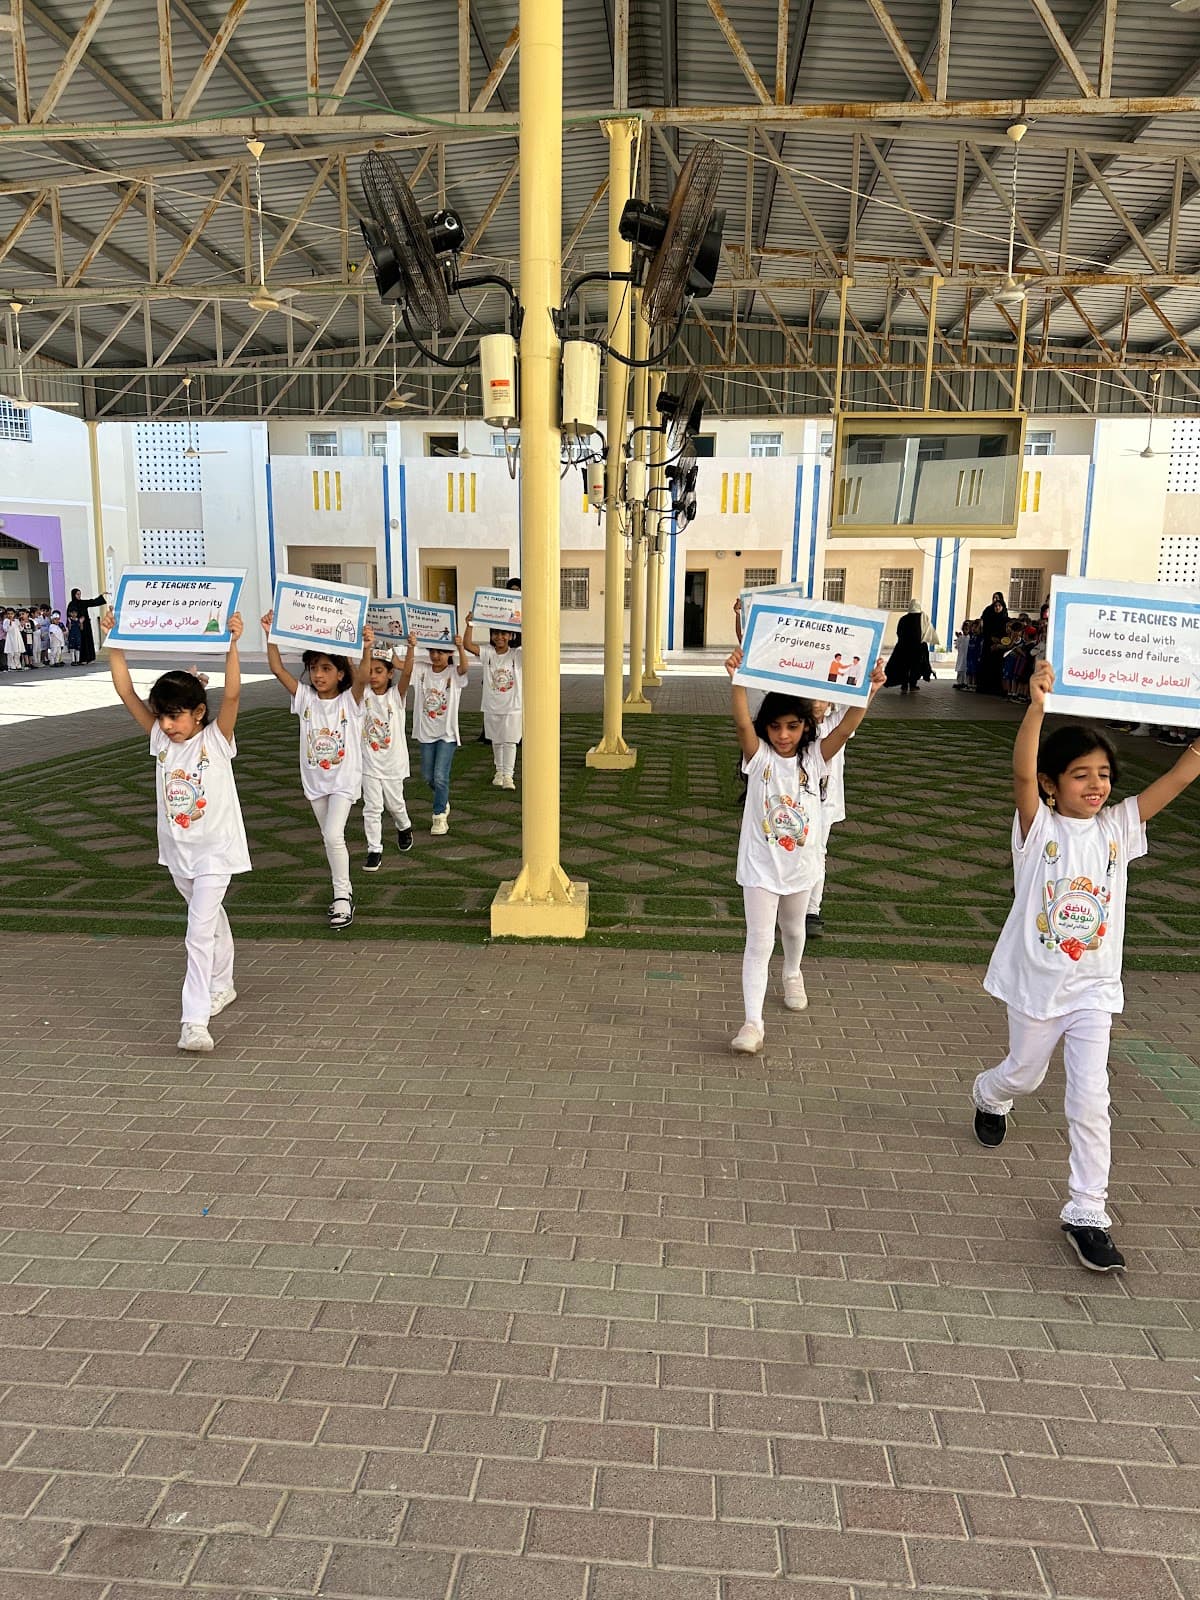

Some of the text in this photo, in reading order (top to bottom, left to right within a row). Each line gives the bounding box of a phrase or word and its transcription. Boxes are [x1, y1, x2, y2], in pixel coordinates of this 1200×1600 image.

[128, 600, 140, 608] my
[142, 600, 171, 608] prayer
[189, 599, 223, 608] priority
[306, 592, 334, 603] TEACHES
[292, 600, 306, 608] How
[317, 605, 344, 615] respect
[159, 619, 173, 628] هي
[174, 616, 200, 629] صلاتي
[305, 614, 327, 624] others
[778, 617, 791, 626] P.E
[795, 619, 833, 632] TEACHES
[1098, 609, 1117, 621] P.E
[1122, 611, 1177, 627] TEACHES
[774, 634, 831, 651] Forgiveness
[1089, 628, 1175, 646] How to deal with
[1082, 647, 1180, 663] success and failure
[779, 657, 814, 671] التسامح
[1067, 667, 1190, 688] التعامل مع النجاح والهزيمة
[1065, 904, 1090, 915] رياضة
